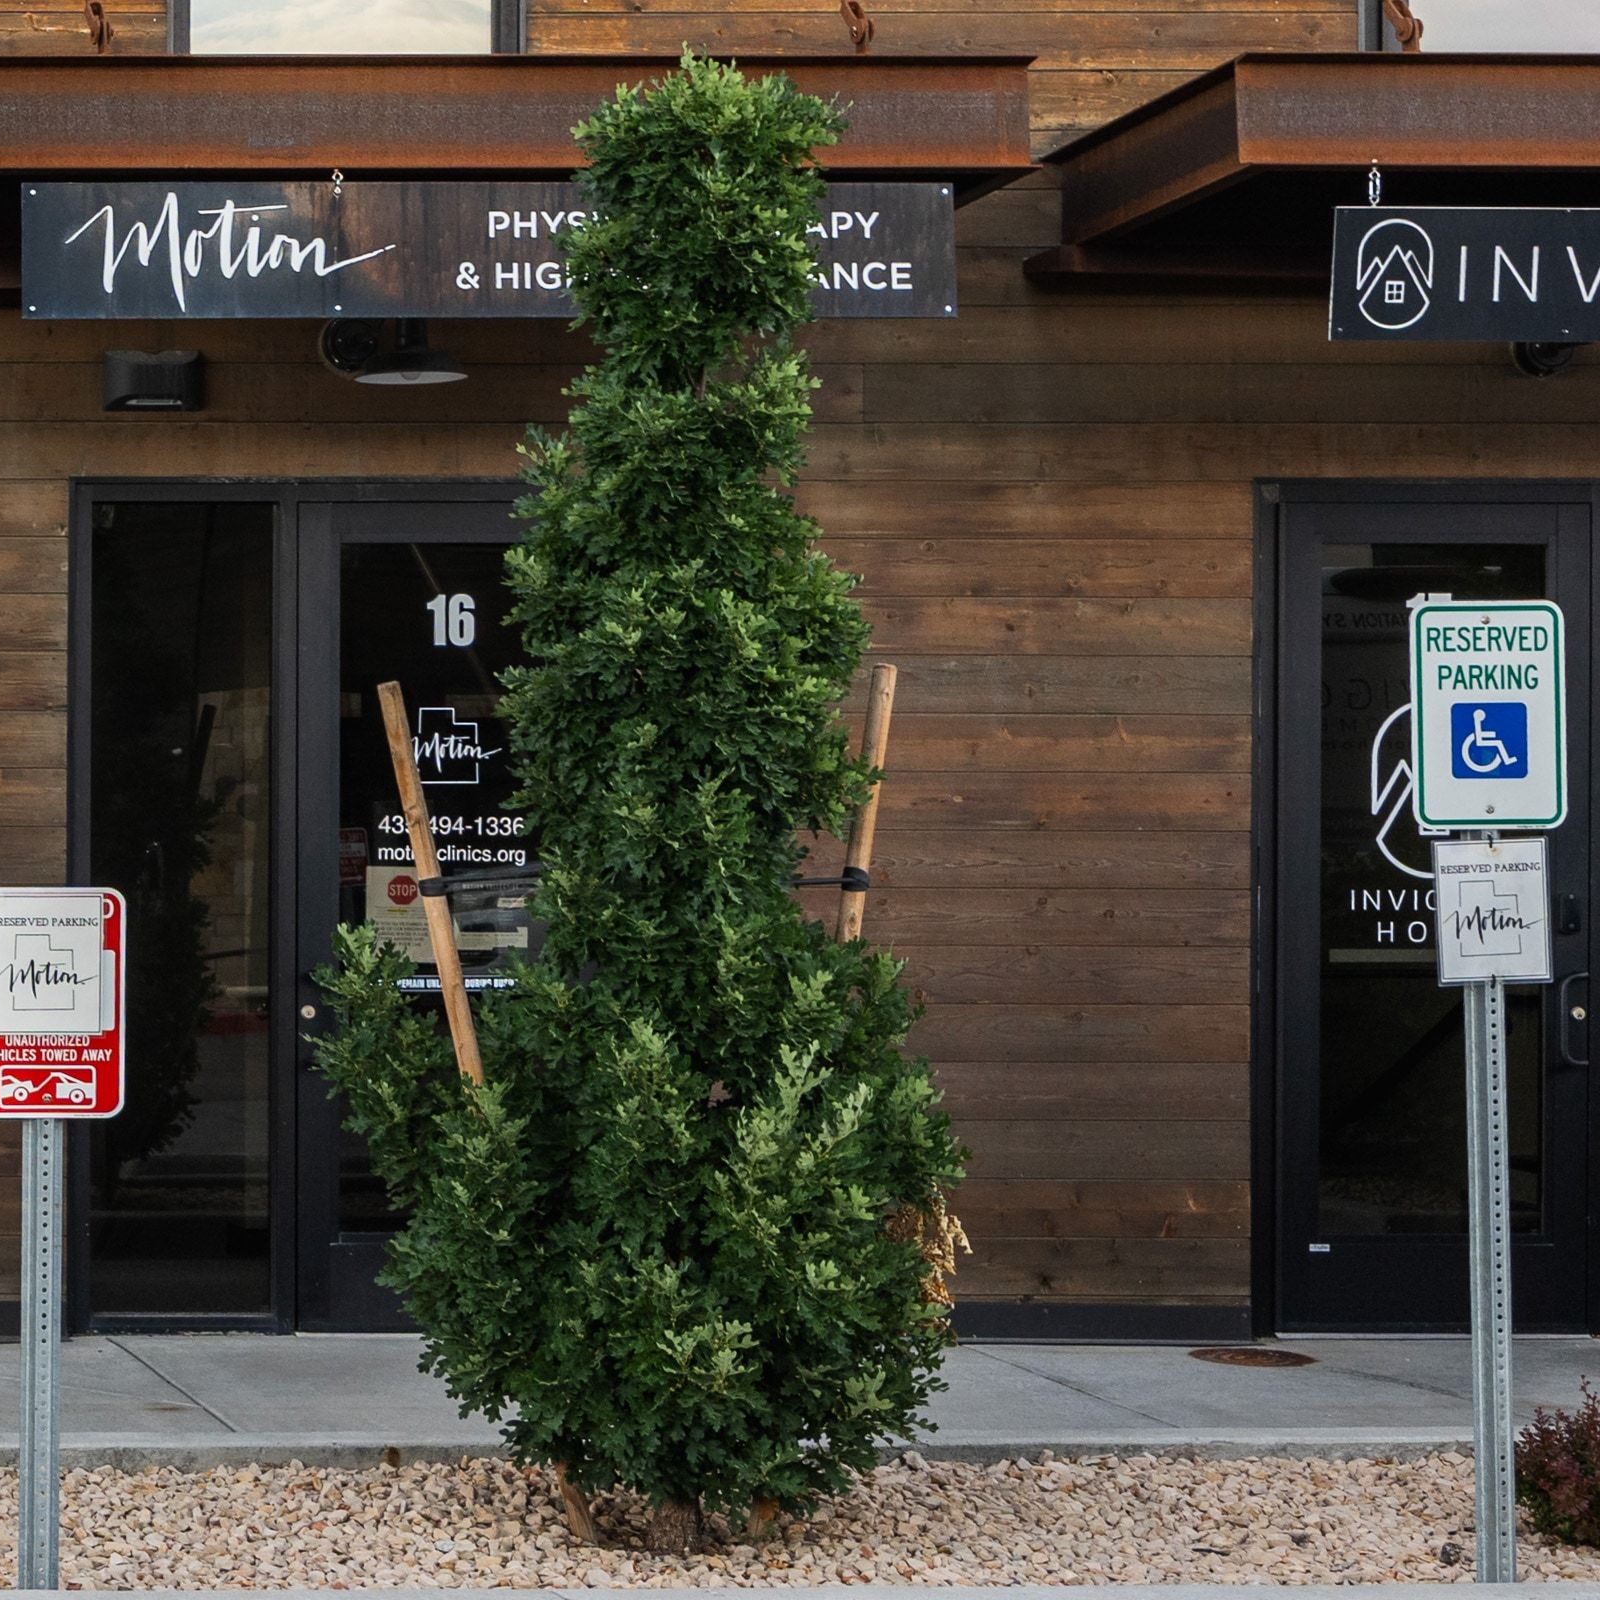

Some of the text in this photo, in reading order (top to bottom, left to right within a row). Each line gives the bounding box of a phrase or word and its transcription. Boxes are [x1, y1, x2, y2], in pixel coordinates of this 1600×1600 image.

[65, 191, 396, 312] Motion
[456, 262, 480, 289] &
[426, 593, 476, 647] 16
[1426, 626, 1548, 653] RESERVED
[1438, 664, 1539, 691] PARKING
[1440, 862, 1541, 875] RESERVED PARKING
[389, 884, 416, 897] STOP
[51, 917, 99, 927] PARKING
[4, 1034, 90, 1047] UNAUTHORIZED
[40, 1049, 77, 1062] TOWED
[81, 1049, 113, 1062] AWAY
